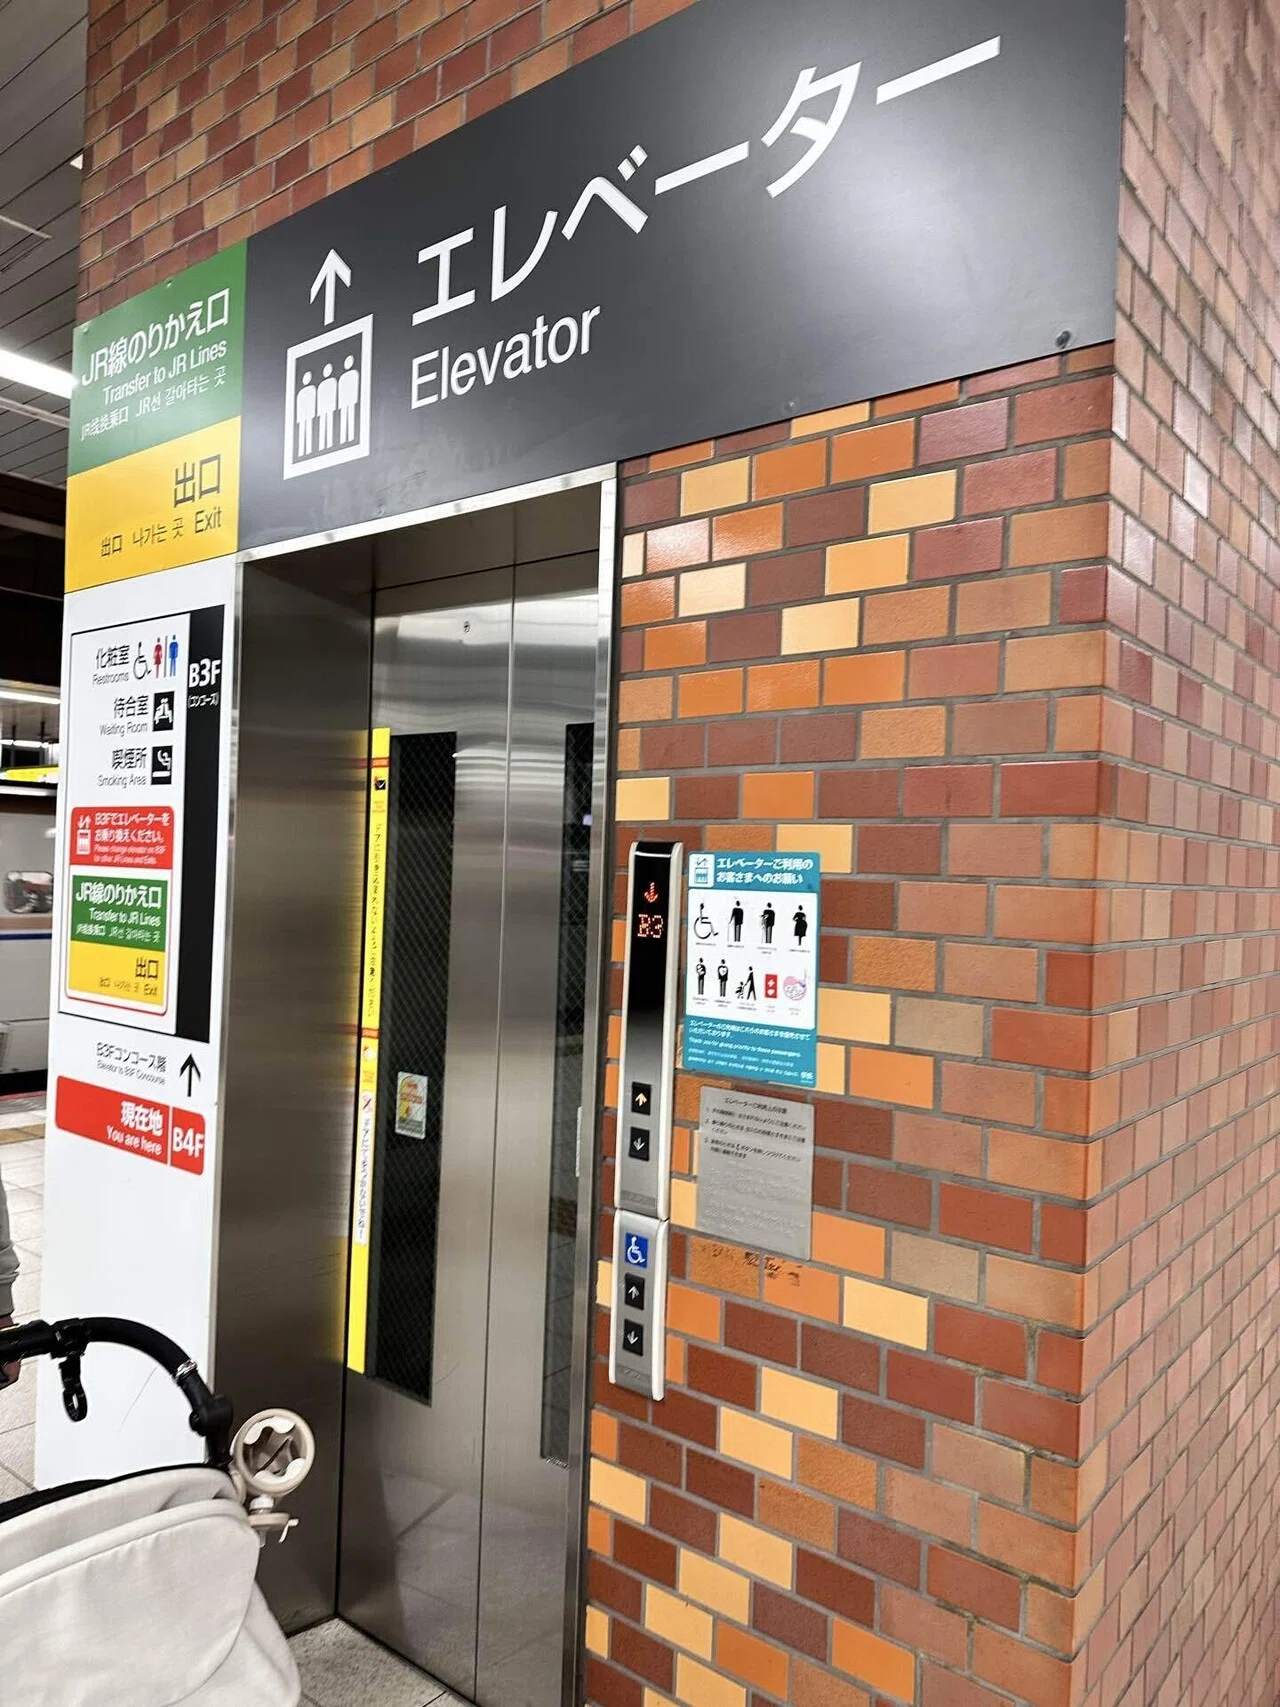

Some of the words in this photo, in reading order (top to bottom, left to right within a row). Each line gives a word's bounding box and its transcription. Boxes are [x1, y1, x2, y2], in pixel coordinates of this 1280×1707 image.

[412, 36, 1000, 326] エレベーター
[82, 288, 229, 386] JR線のりかえ口
[411, 305, 601, 410] Elevator
[103, 372, 151, 406] Transfer
[153, 366, 165, 384] to
[168, 352, 187, 378] JR
[190, 340, 227, 369] Lines
[165, 374, 210, 406] 갈아타는
[213, 365, 227, 388] 곳
[174, 453, 221, 508] 出口
[133, 523, 167, 548] 나가는
[172, 517, 184, 539] 곳
[195, 506, 222, 534] Exit
[101, 533, 122, 557] 出口
[96, 645, 130, 669] 化粧室
[92, 672, 129, 686] Restrooms
[188, 657, 221, 688] B3F
[113, 694, 149, 719] 待合室
[99, 723, 125, 737] Waiting
[126, 721, 148, 734] Room
[98, 774, 127, 789] Smoking
[129, 774, 147, 786] Area
[76, 881, 162, 909] JR線のりかえ口
[89, 907, 119, 922] Transfer
[139, 911, 161, 927] Lines
[637, 914, 664, 938] B3
[135, 956, 159, 981] 出口
[121, 1100, 164, 1137] 現在地
[106, 1124, 123, 1144] You
[124, 1133, 140, 1149] are
[140, 1136, 162, 1156] here
[173, 1127, 205, 1158] B4F
